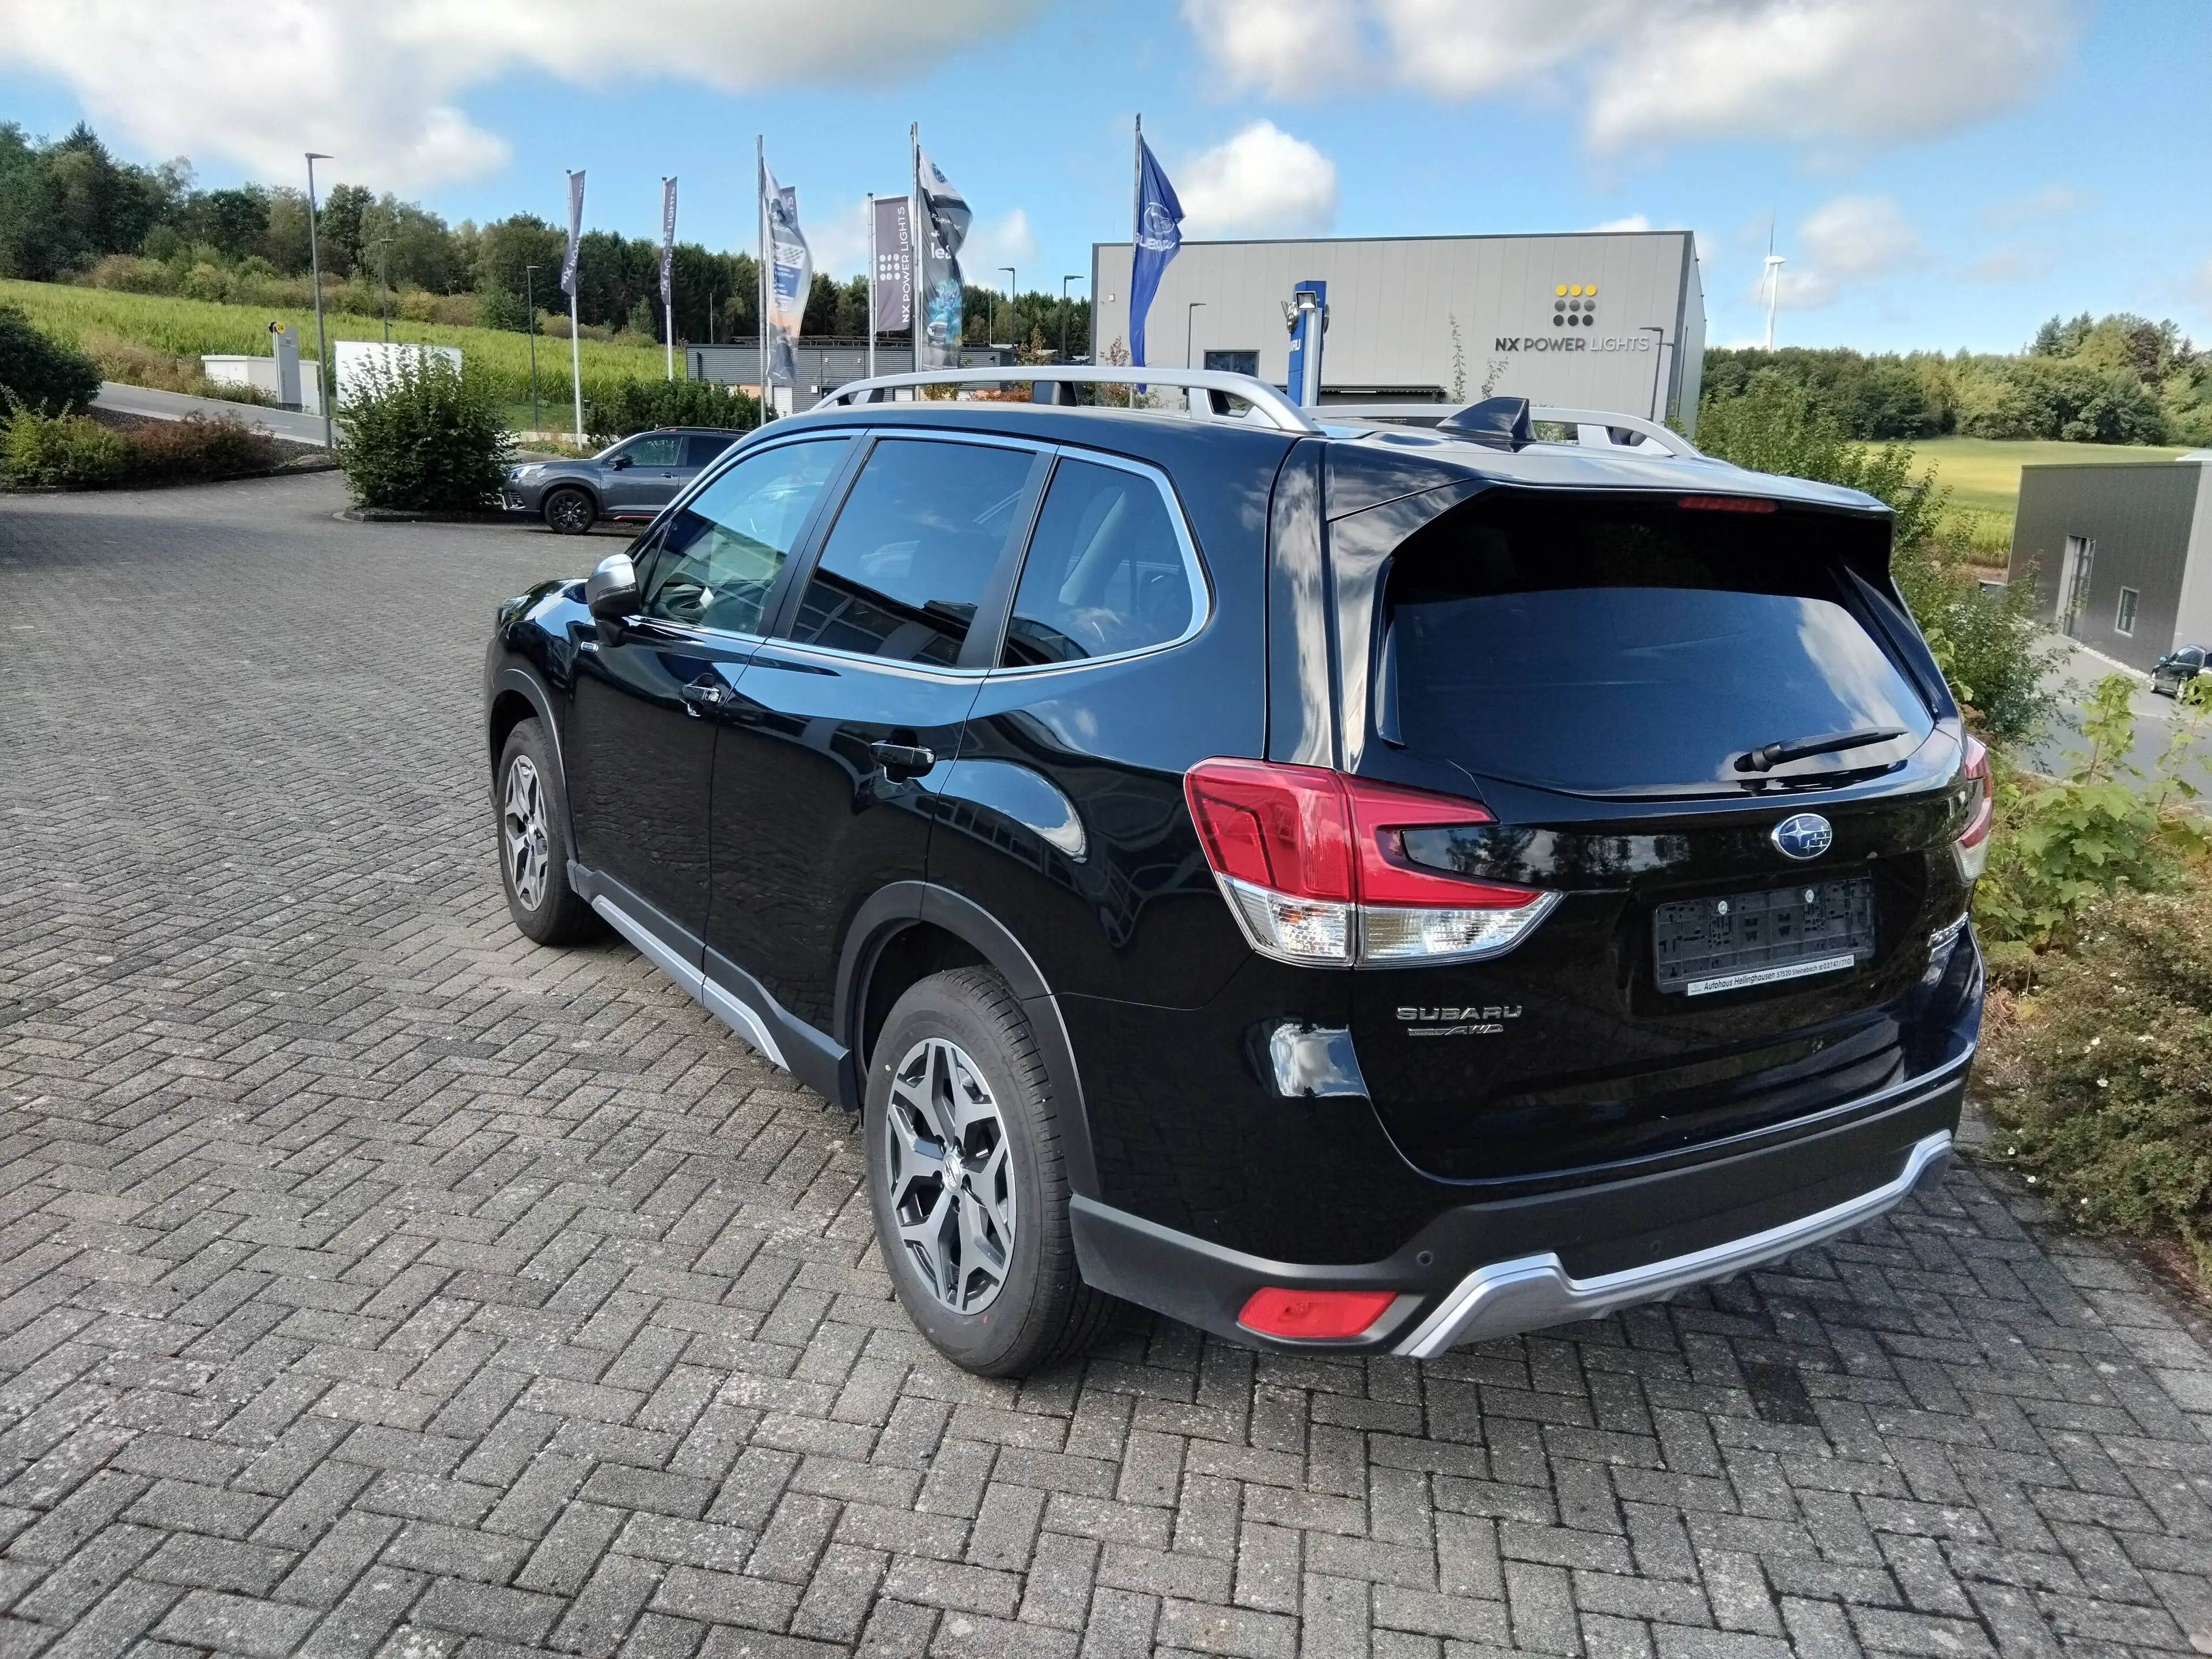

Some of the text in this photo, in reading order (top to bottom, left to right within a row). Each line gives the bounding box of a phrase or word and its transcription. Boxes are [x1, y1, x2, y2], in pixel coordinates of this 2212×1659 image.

[897, 206, 911, 323] NX POWER LIGHTS
[1495, 336, 1650, 352] NX POWER LIGHTS
[1704, 979, 1733, 990] Autohaus
[1734, 972, 1775, 986] Hellinghausen
[1792, 965, 1817, 975] Steinebach
[1397, 1006, 1522, 1020] SUBARU
[1444, 1024, 1504, 1035] AWD
